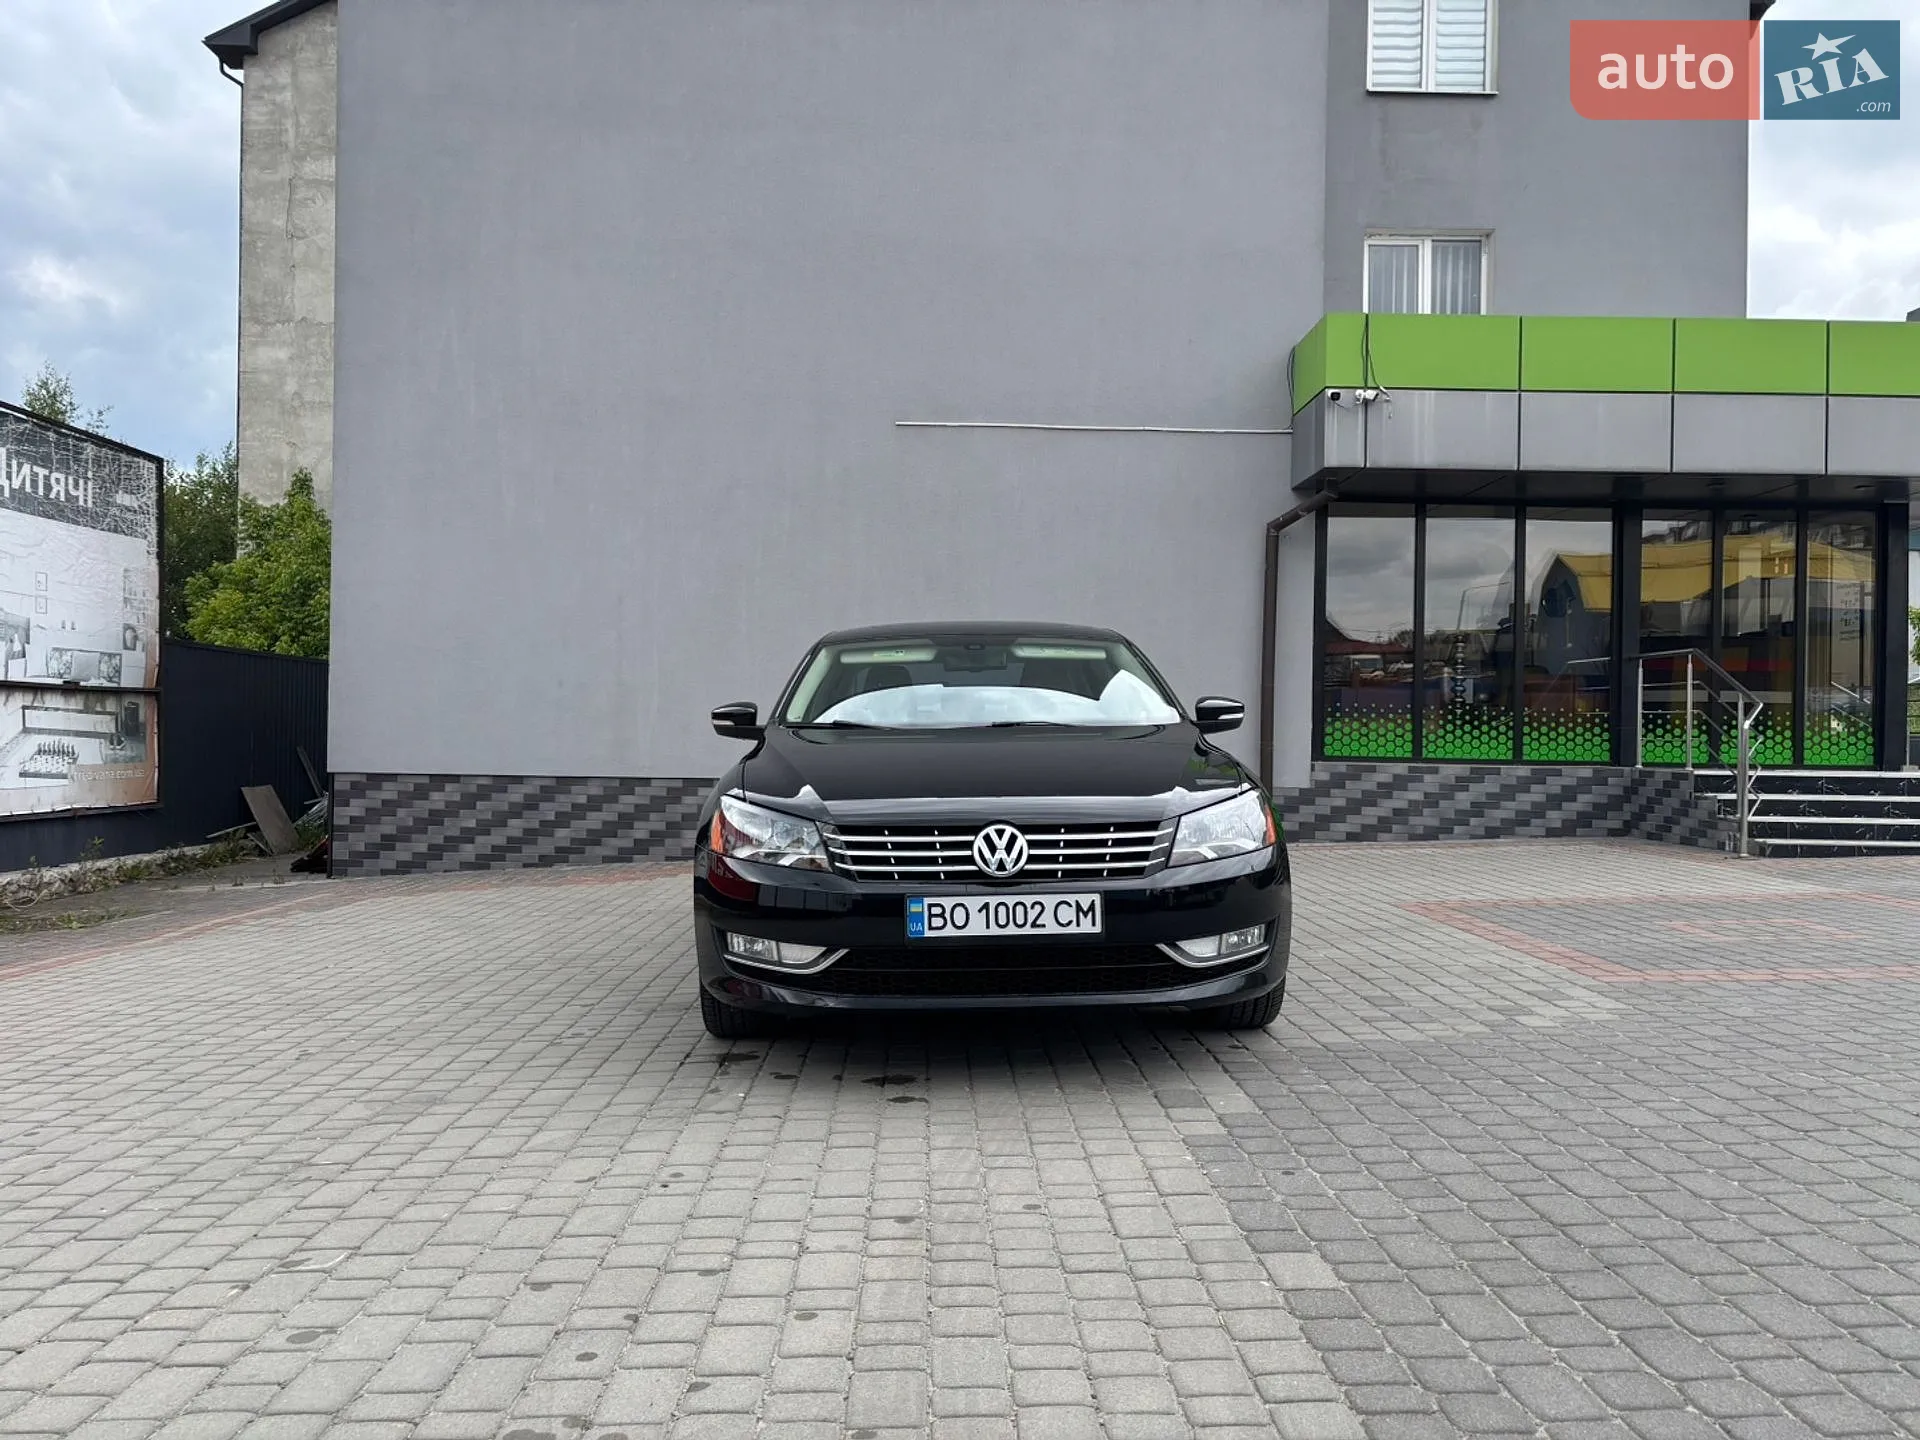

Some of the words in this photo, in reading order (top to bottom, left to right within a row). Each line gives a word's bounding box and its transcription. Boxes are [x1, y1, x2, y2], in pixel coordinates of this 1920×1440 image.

[926, 902, 970, 931] BO
[977, 901, 1046, 930] 1002
[1053, 899, 1096, 928] CM
[910, 922, 923, 931] UA
